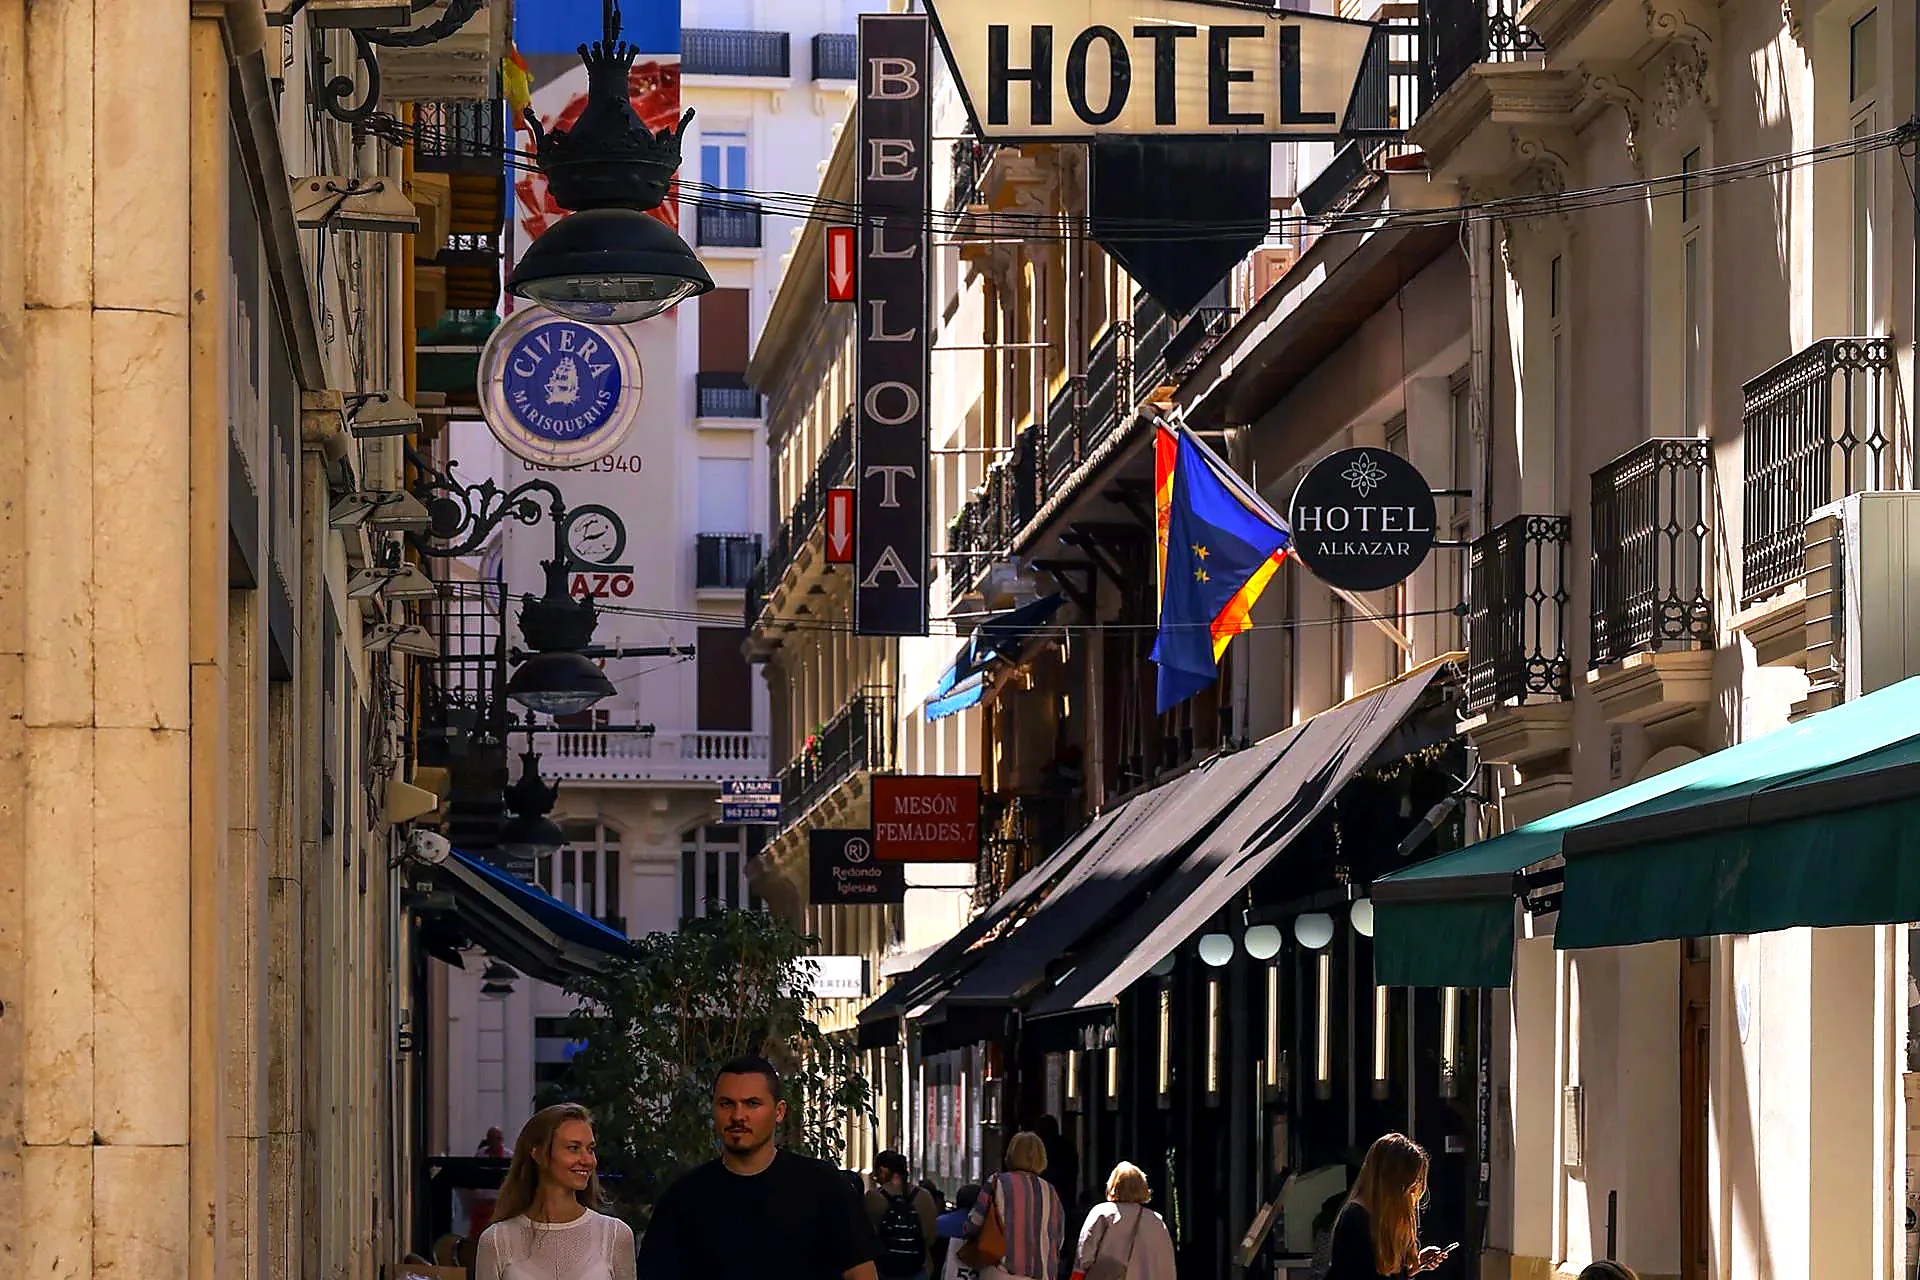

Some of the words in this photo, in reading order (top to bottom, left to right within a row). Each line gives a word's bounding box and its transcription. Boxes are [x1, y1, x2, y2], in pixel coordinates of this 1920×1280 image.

[988, 25, 1336, 126] HOTEL
[860, 57, 920, 588] BELLOTA
[513, 329, 612, 379] CIVERA
[512, 388, 612, 436] MARISQUERIAS
[590, 454, 642, 473] 1940
[1298, 506, 1430, 532] HOTEL
[1317, 541, 1411, 556] ALKAZAR
[570, 573, 634, 598] AZO
[746, 782, 772, 791] ALAIN
[894, 793, 957, 815] MESÓN
[832, 866, 882, 881] Redondo
[837, 881, 878, 895] Iglesias
